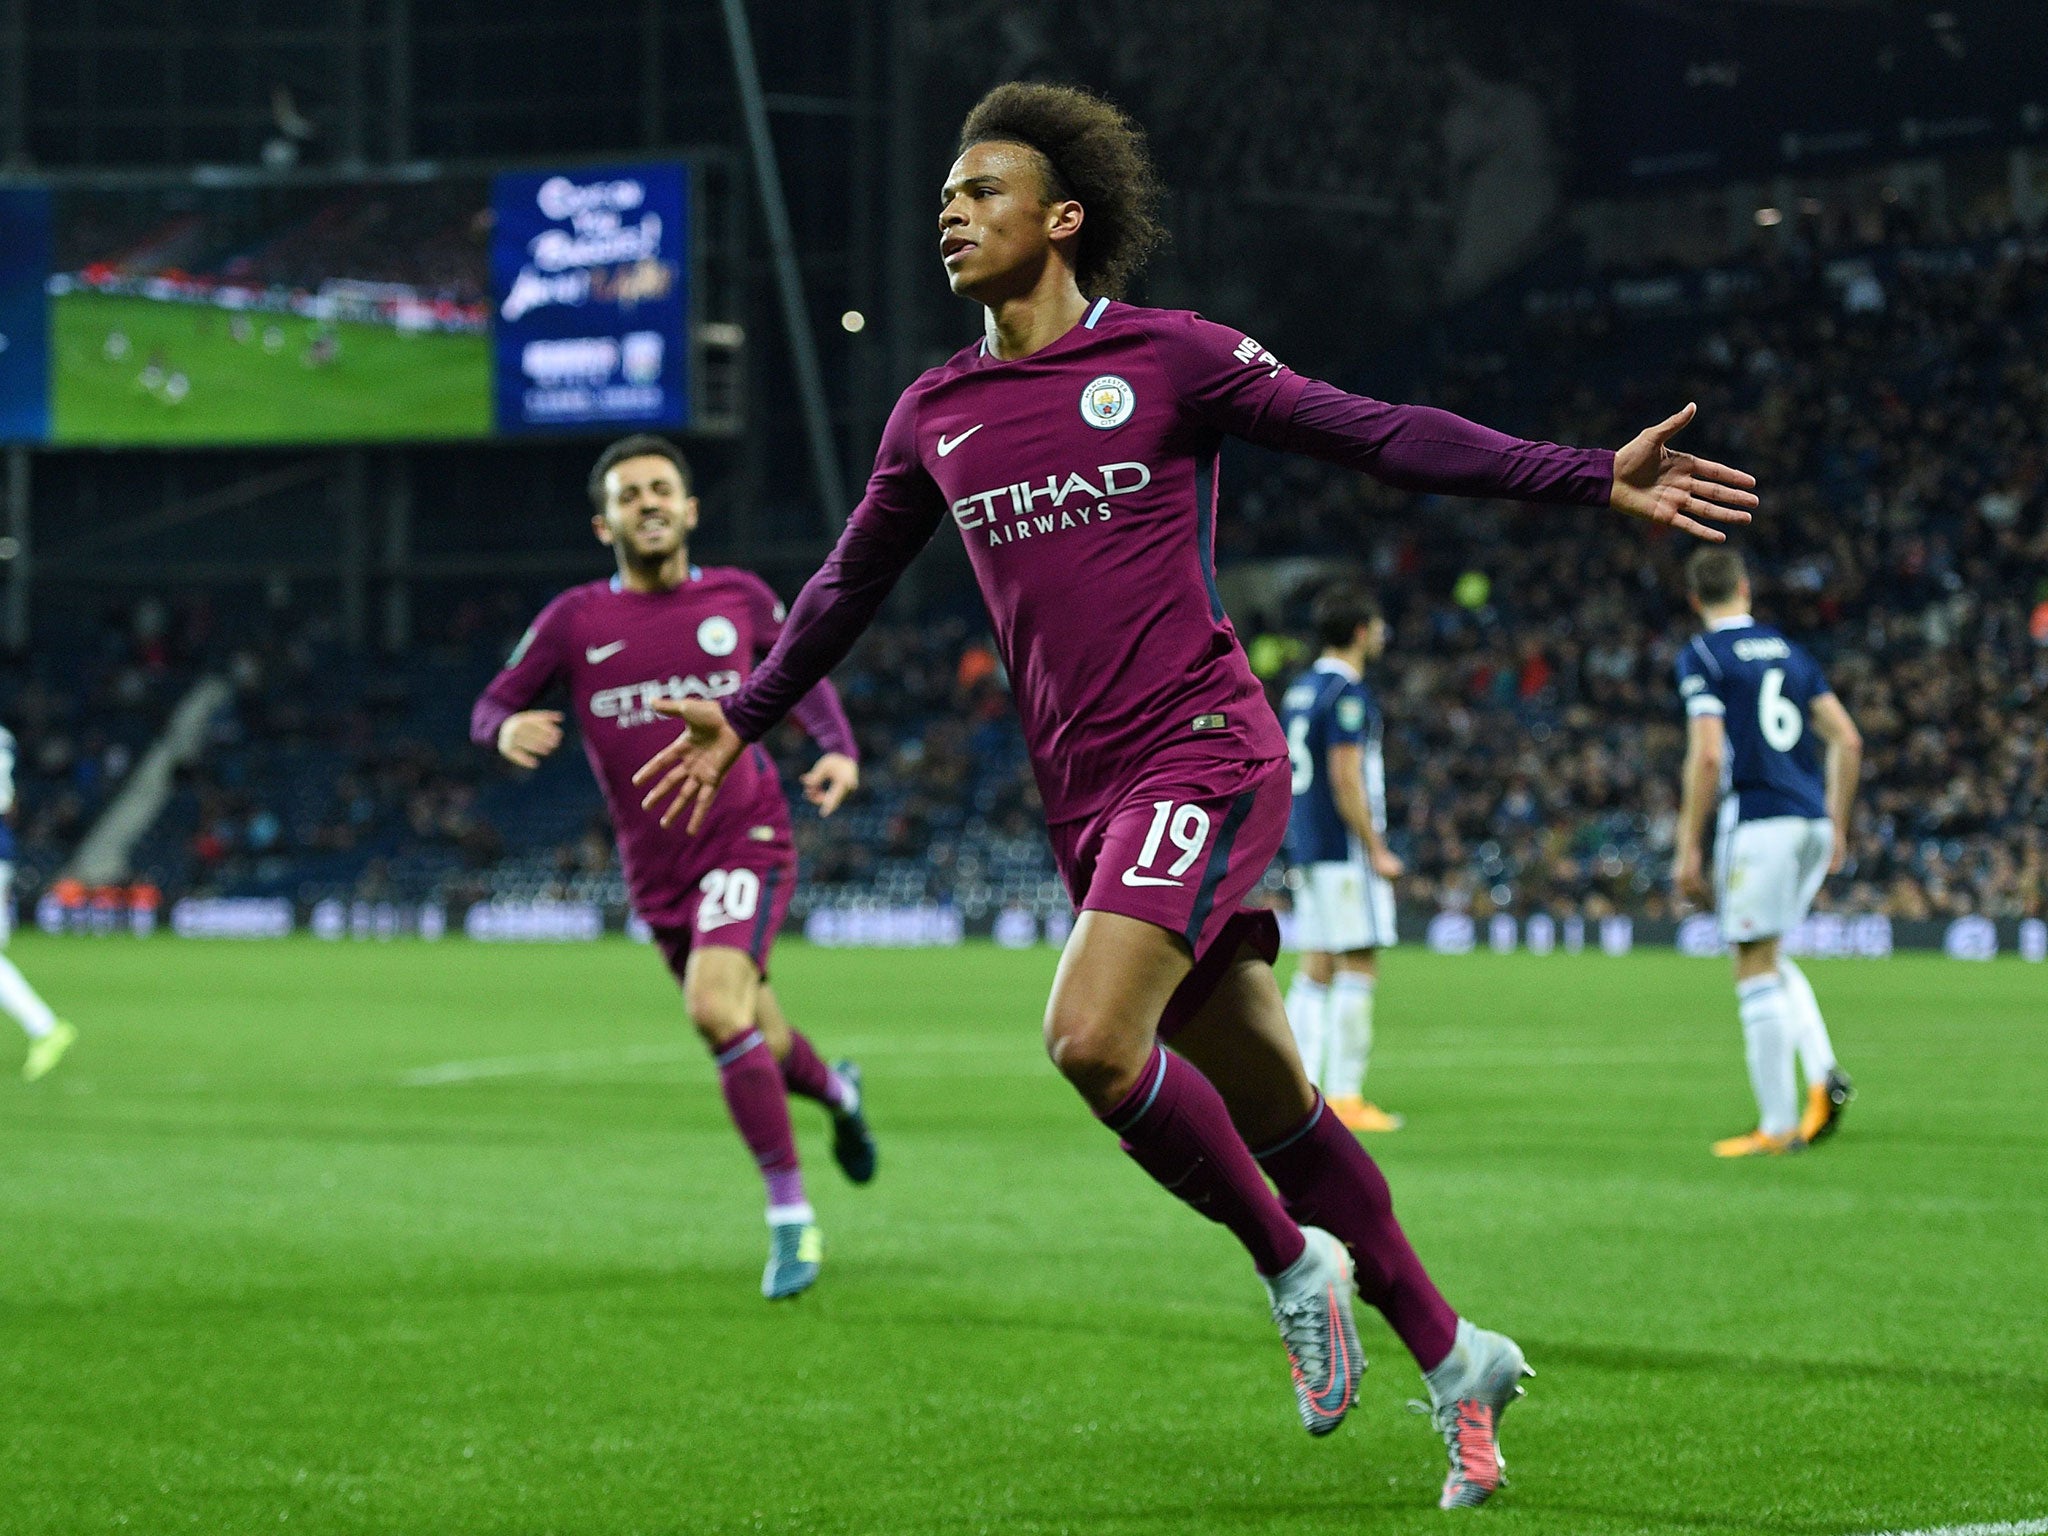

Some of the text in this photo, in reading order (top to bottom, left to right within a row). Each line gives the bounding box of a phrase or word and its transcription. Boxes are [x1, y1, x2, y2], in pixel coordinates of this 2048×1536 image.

[1085, 379, 1128, 398] MANCHESTER
[952, 461, 1151, 531] ETIHAD
[989, 502, 1112, 547] AIRWAYS
[1758, 667, 1803, 752] 6
[1136, 800, 1210, 877] 19
[697, 867, 760, 933] 20
